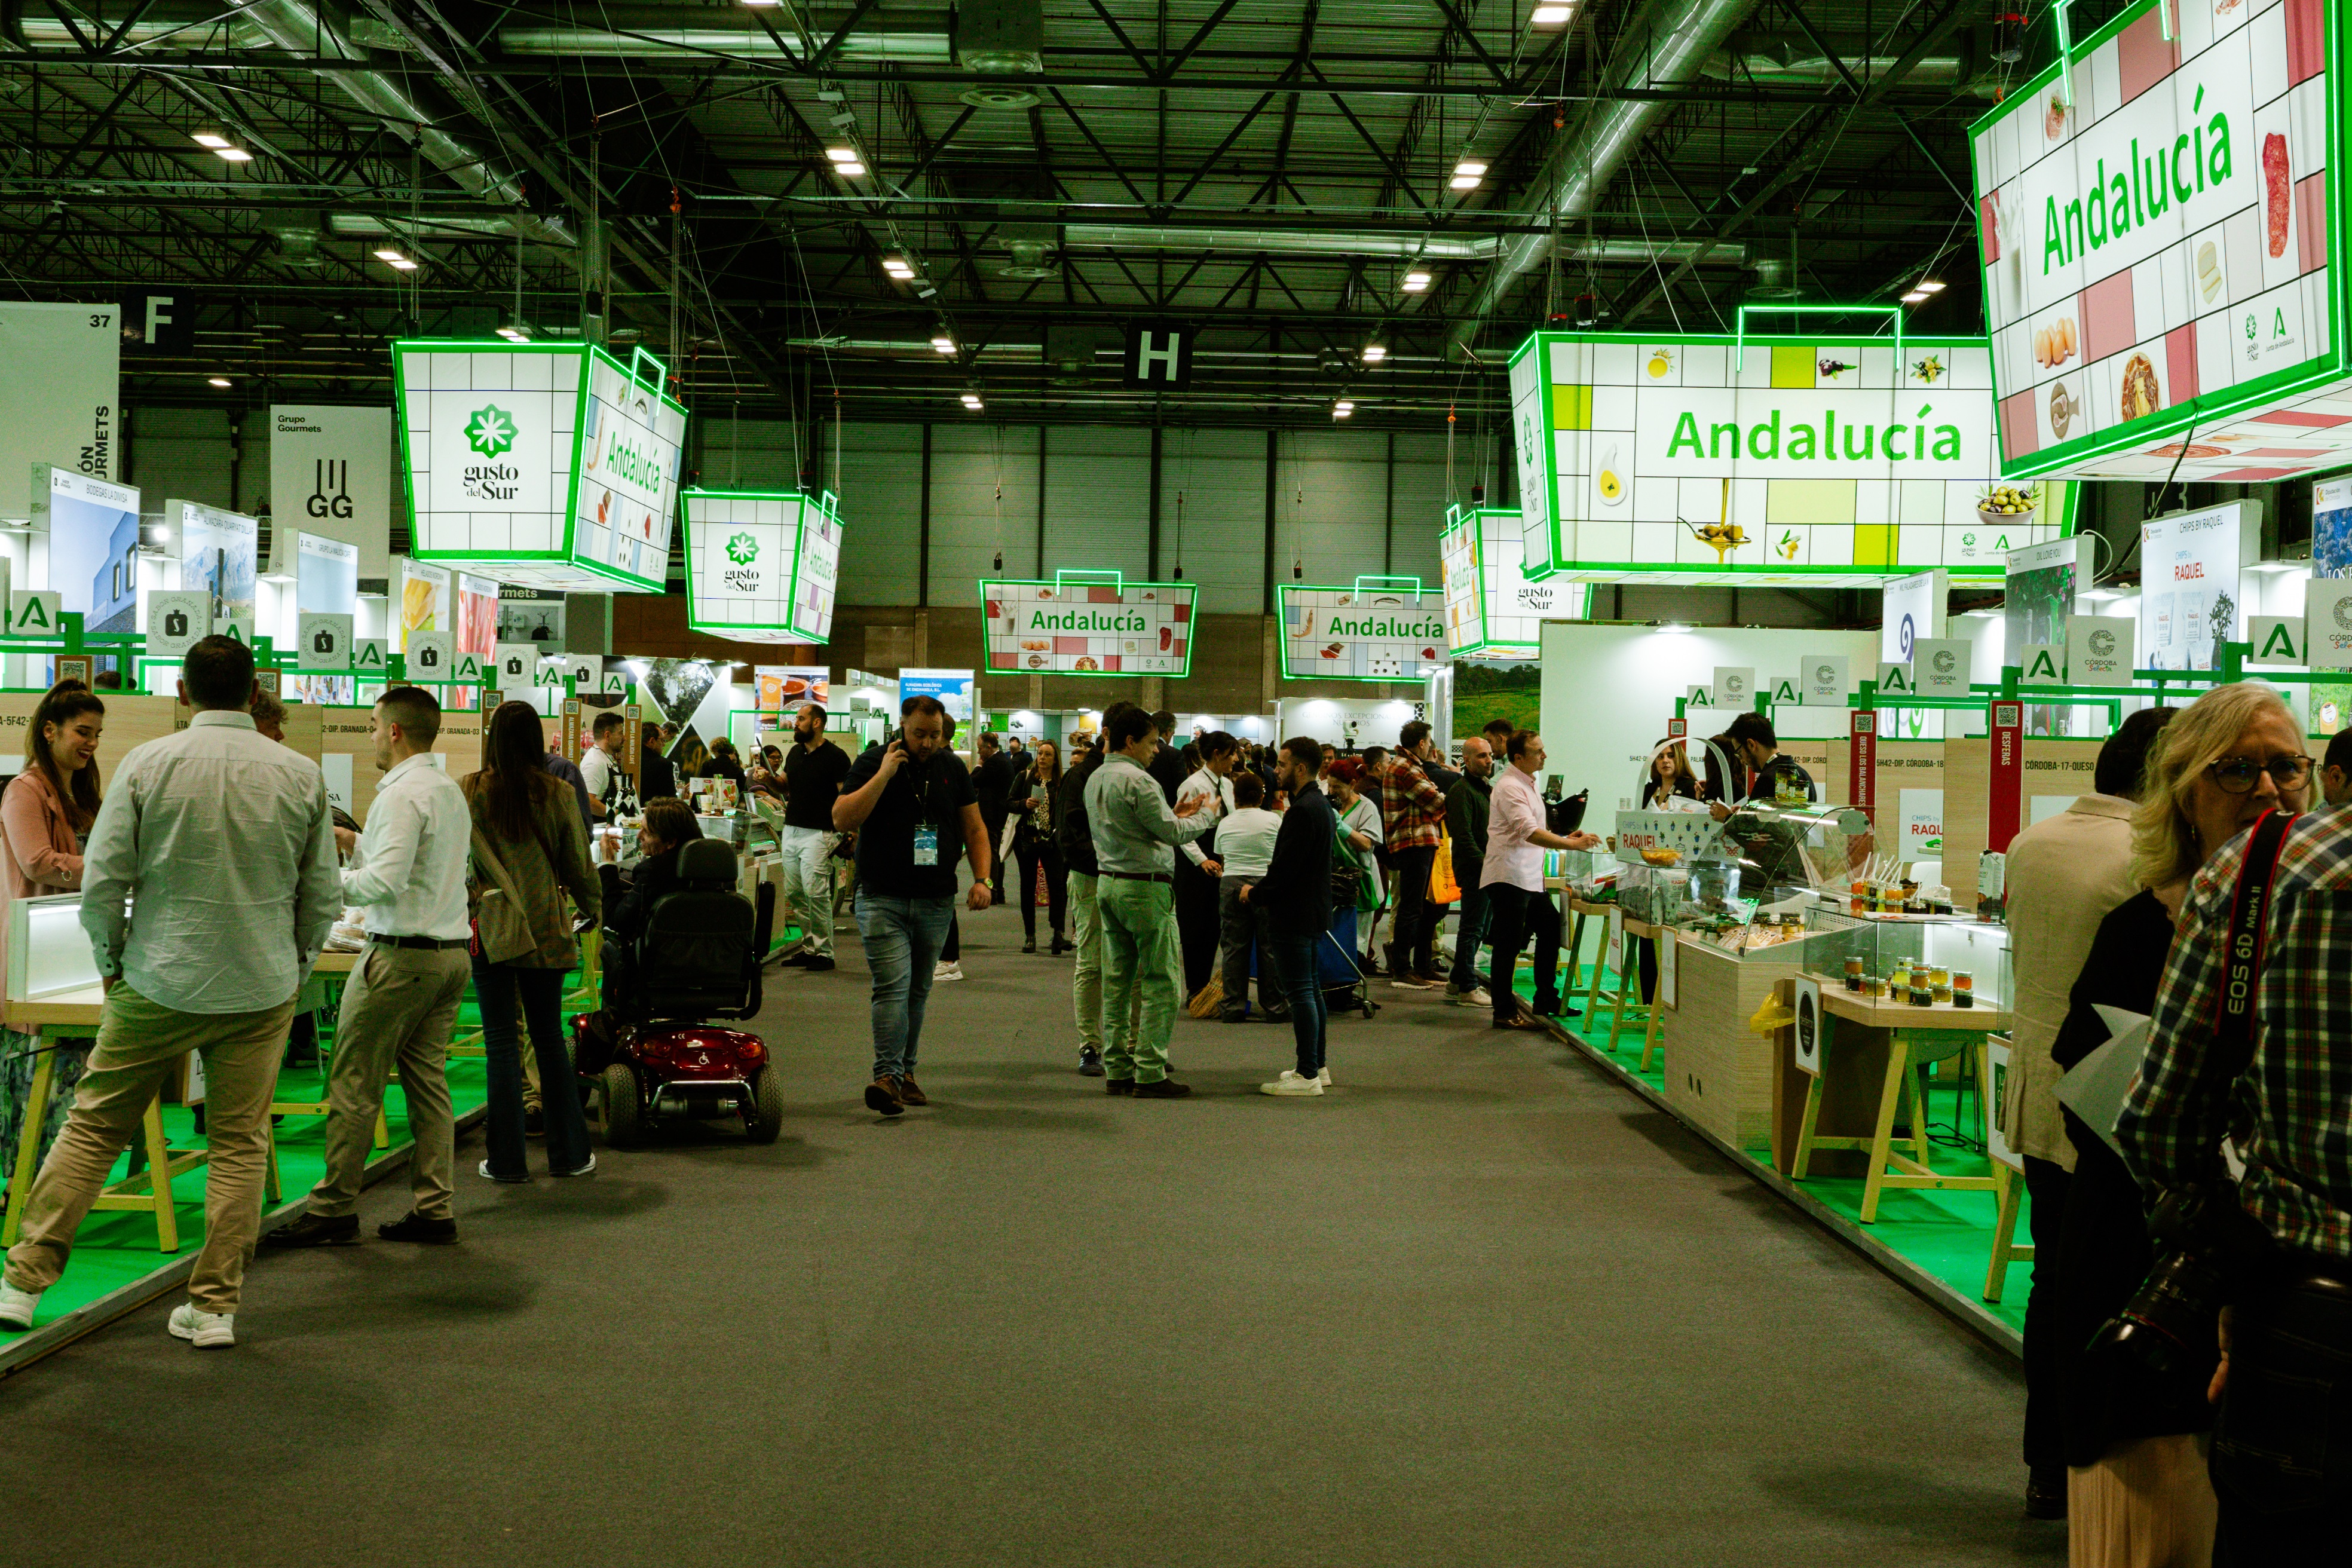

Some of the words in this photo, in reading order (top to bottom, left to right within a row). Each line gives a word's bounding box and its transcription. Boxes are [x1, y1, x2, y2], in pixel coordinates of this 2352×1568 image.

[2043, 82, 2232, 276] Andalucía
[90, 315, 111, 327] 37
[145, 296, 173, 344] F
[1138, 331, 1180, 381] H
[278, 415, 305, 424] Grupo
[278, 424, 321, 433] Gourmets
[1666, 402, 1961, 461] Andalucía
[607, 430, 660, 494] Andalucía
[463, 463, 519, 488] gusto
[86, 484, 108, 498] BODEGAS
[108, 490, 113, 500] LA
[114, 491, 128, 503] DIVISA
[467, 487, 480, 497] del
[482, 480, 519, 500] Sur
[204, 516, 223, 528] ALMAZARA
[2180, 520, 2194, 534] CHIPS
[2195, 519, 2202, 530] BY
[2203, 514, 2223, 529] RAQUEL
[318, 544, 329, 553] GRUPO
[2043, 550, 2053, 559] LOVE
[2175, 550, 2187, 561] CHIPS
[724, 568, 760, 583] gusto
[2175, 562, 2204, 581] RAQUEL
[498, 589, 538, 598] rmets
[736, 580, 759, 592] Sur
[1518, 586, 1552, 601] gusto
[152, 599, 169, 620] SABOR
[172, 596, 202, 620] GRANADA
[1529, 598, 1552, 610] Sur
[302, 620, 317, 639] SABOR
[318, 619, 345, 639] GRANADA
[1030, 610, 1146, 632] Andalucía
[1328, 615, 1443, 638] Andalucía
[151, 626, 169, 647] SABOR
[170, 627, 202, 648] GRANADA
[2002, 732, 2011, 765] DESFERAS
[1906, 758, 1944, 768] CÓRDOBA-18
[2025, 760, 2094, 771] CÓRDOBA-17-QUESO
[1622, 820, 1636, 829] CHIPS
[1622, 833, 1655, 849] RAQUEL
[2246, 897, 2260, 928] Mark
[2236, 933, 2253, 959] 6D
[2228, 965, 2249, 1015] EOS
